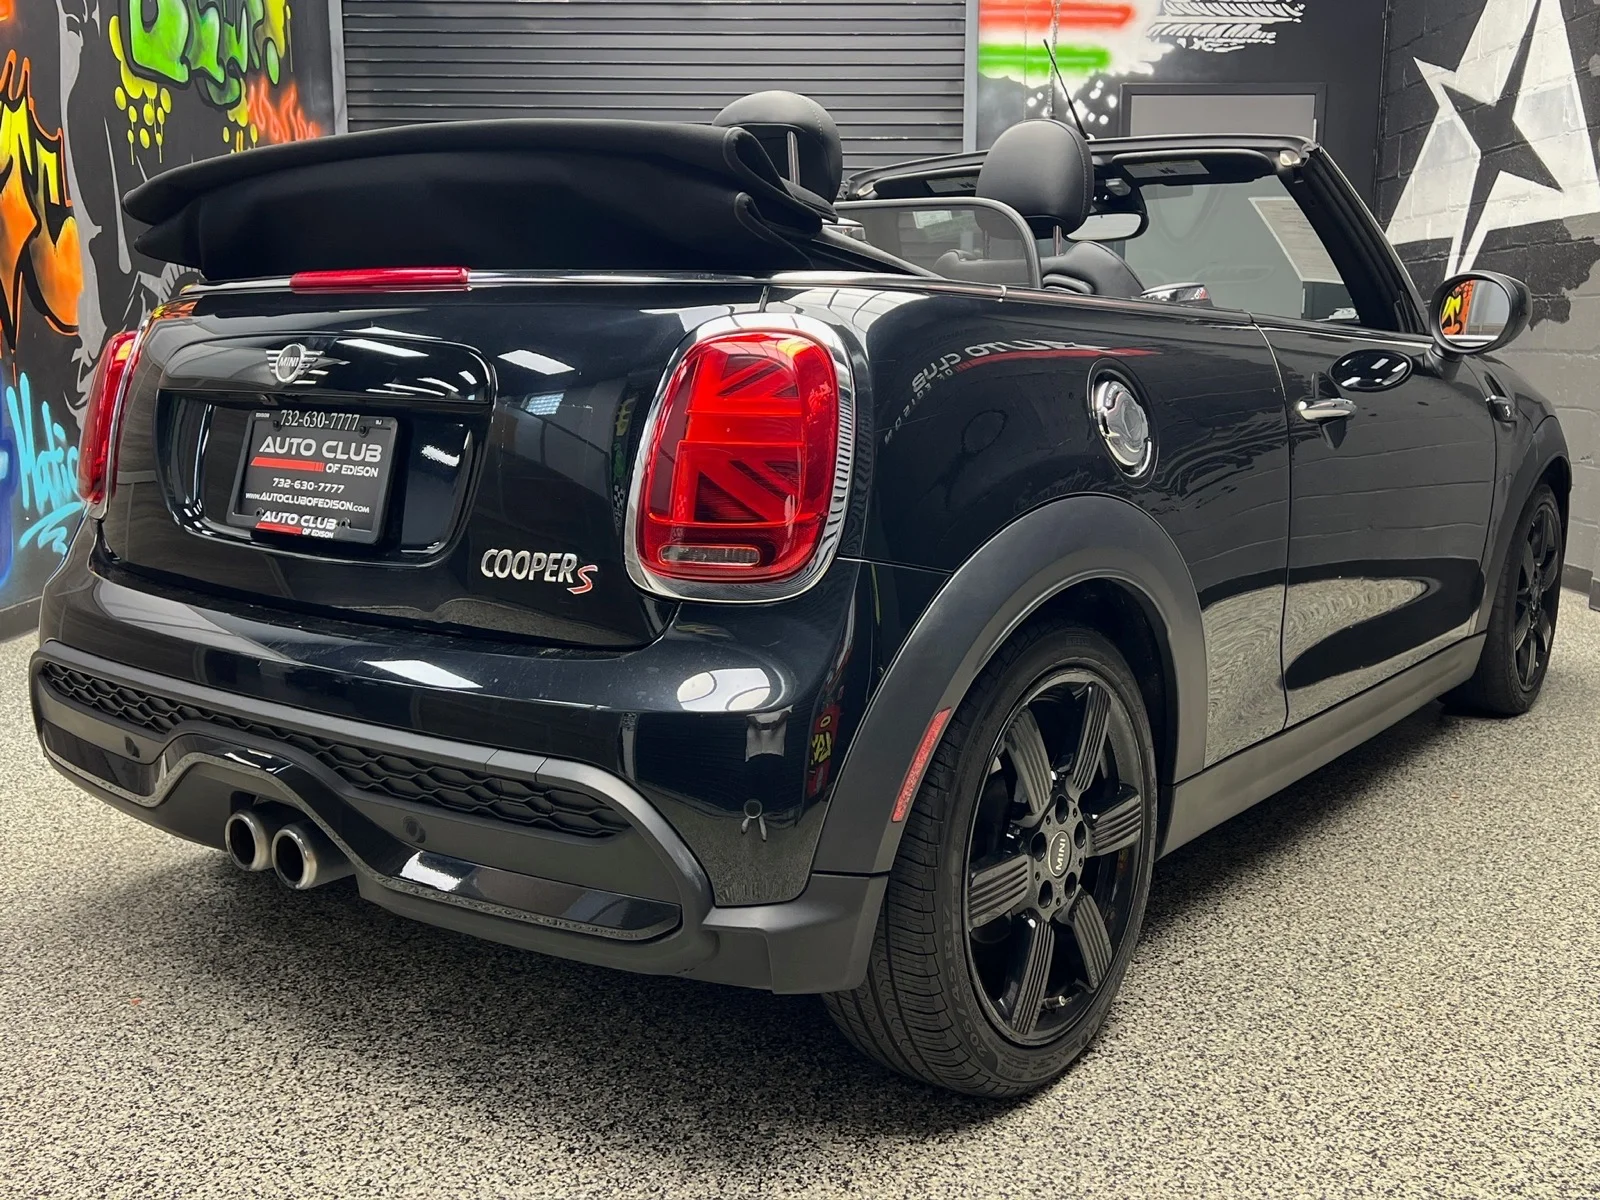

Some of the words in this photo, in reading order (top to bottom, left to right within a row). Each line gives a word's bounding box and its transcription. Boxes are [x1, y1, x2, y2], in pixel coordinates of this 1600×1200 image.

[278, 356, 300, 367] MINI
[280, 409, 360, 431] 732-630-7777
[258, 435, 317, 457] AUTO
[322, 440, 383, 463] CLUB
[325, 463, 341, 474] OF
[341, 464, 379, 478] EDISON
[272, 478, 345, 494] 732-630-7777
[260, 510, 299, 526] AUTO
[300, 514, 338, 531] CLUB
[302, 528, 314, 536] OF
[311, 529, 335, 539] EDISON
[481, 548, 578, 583] COOPER
[1055, 838, 1066, 870] MINI
